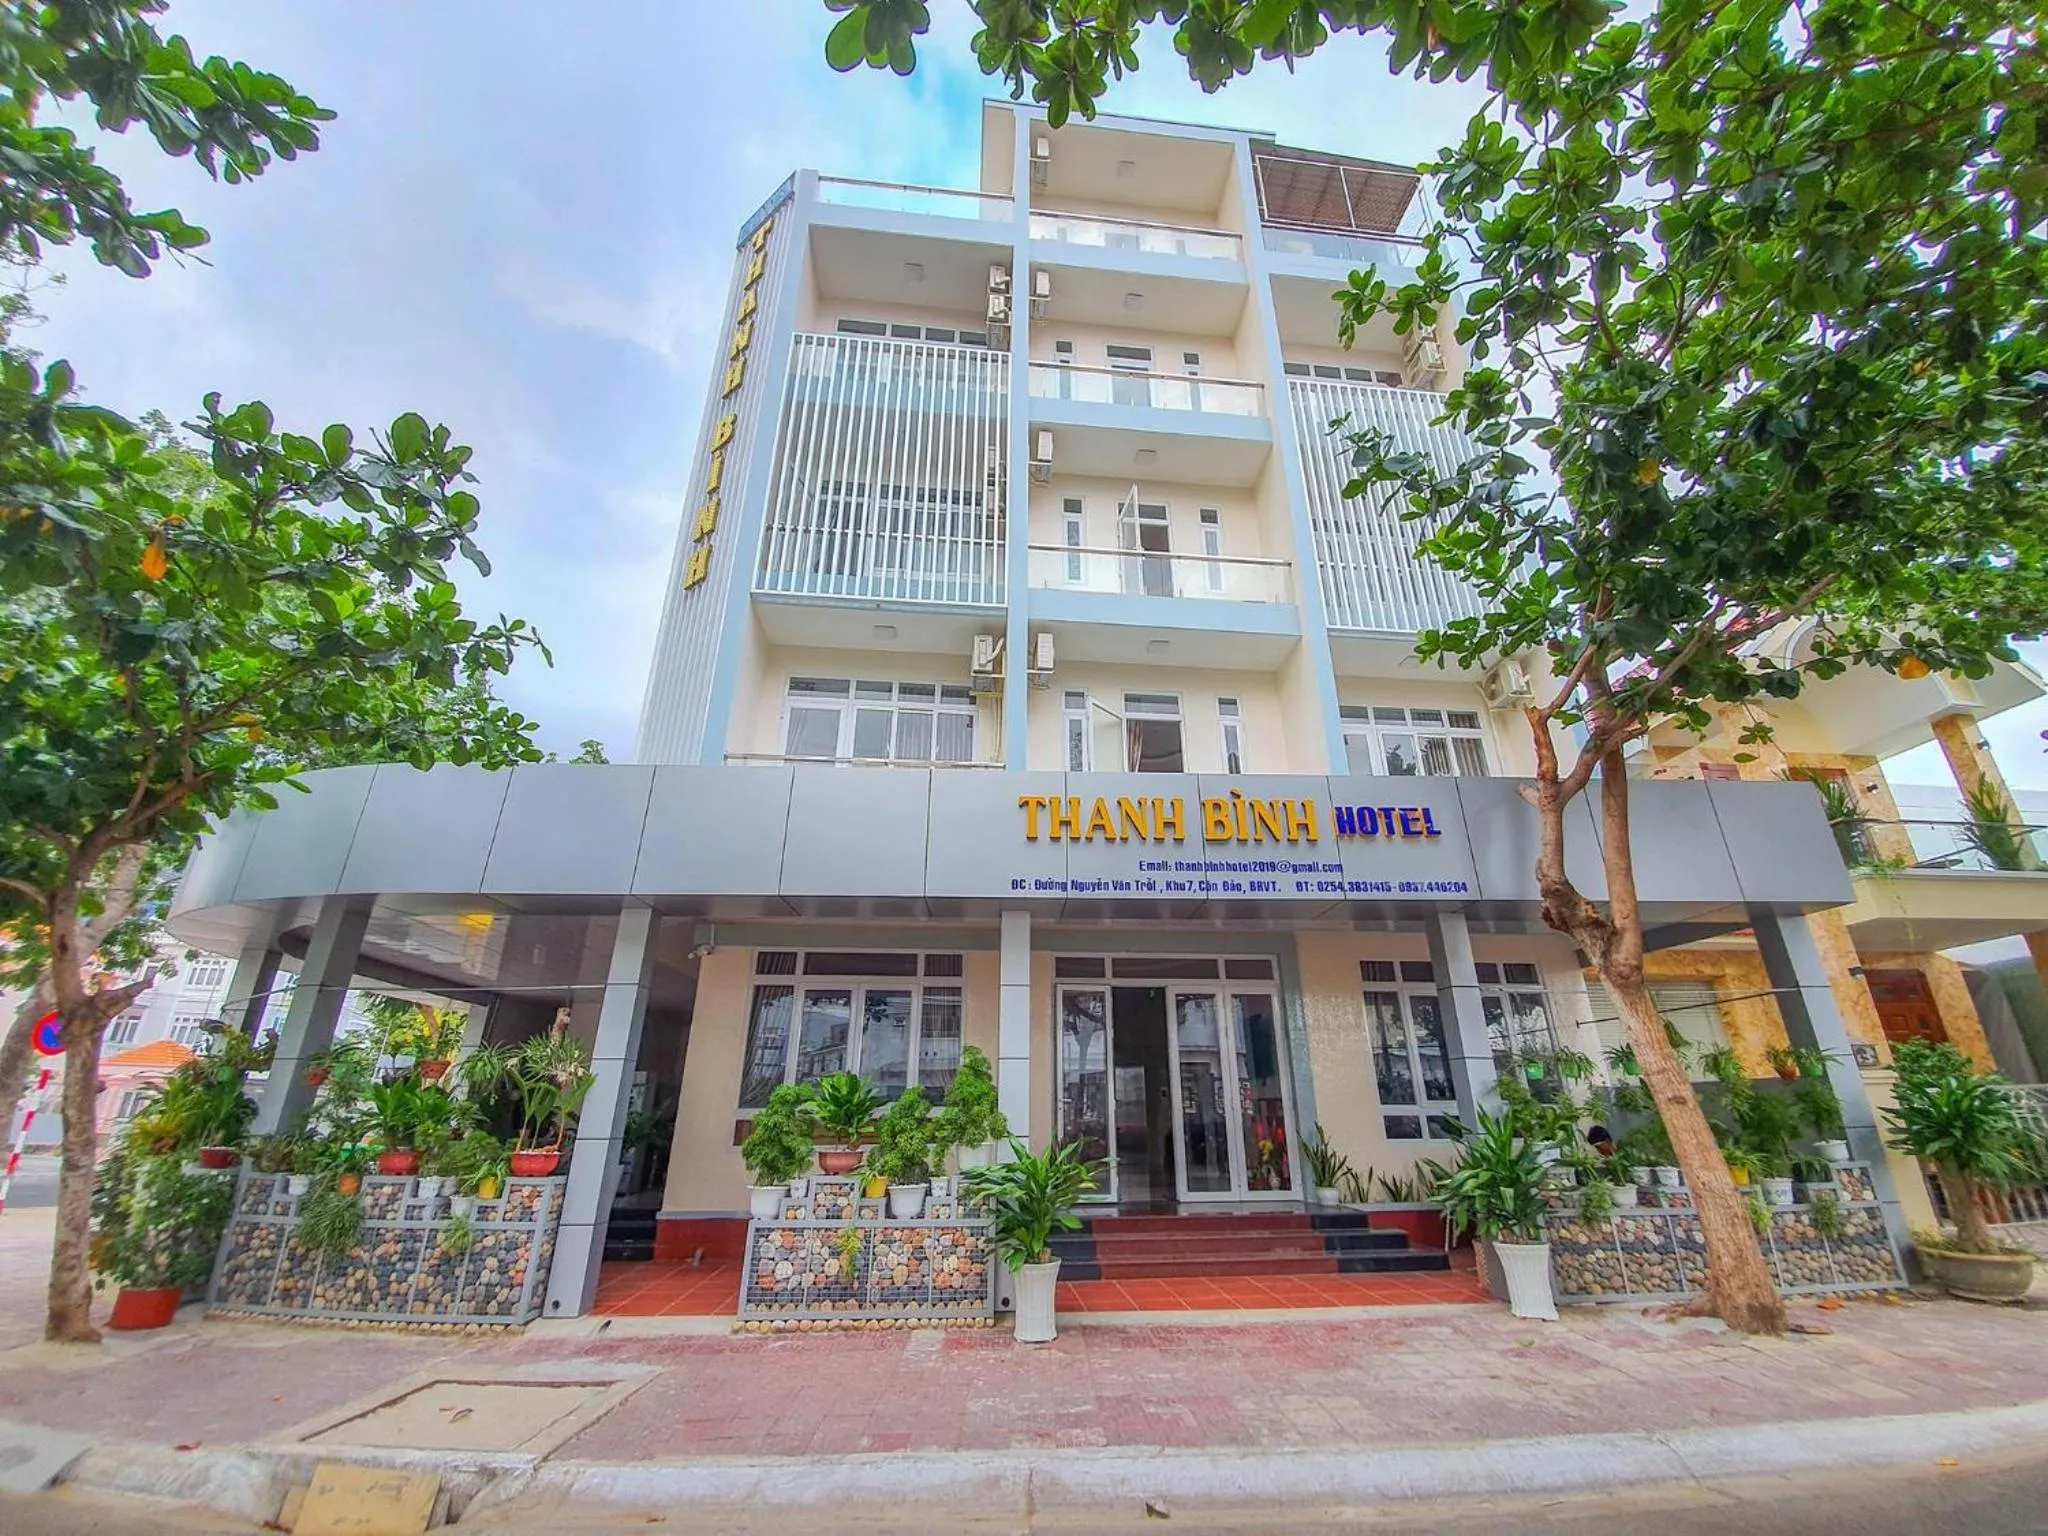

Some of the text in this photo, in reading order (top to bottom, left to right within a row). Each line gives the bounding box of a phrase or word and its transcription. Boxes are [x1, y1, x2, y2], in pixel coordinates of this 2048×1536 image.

[684, 217, 774, 591] THANH BÌNH
[1018, 787, 1442, 842] THANH BÌNH HOTEL
[1138, 859, 1343, 874] Email: thanhbinhhotel2019@gmail.com
[1034, 877, 1068, 892] Đường
[1249, 880, 1281, 892] BRVT.
[1295, 880, 1314, 893] ĐT:
